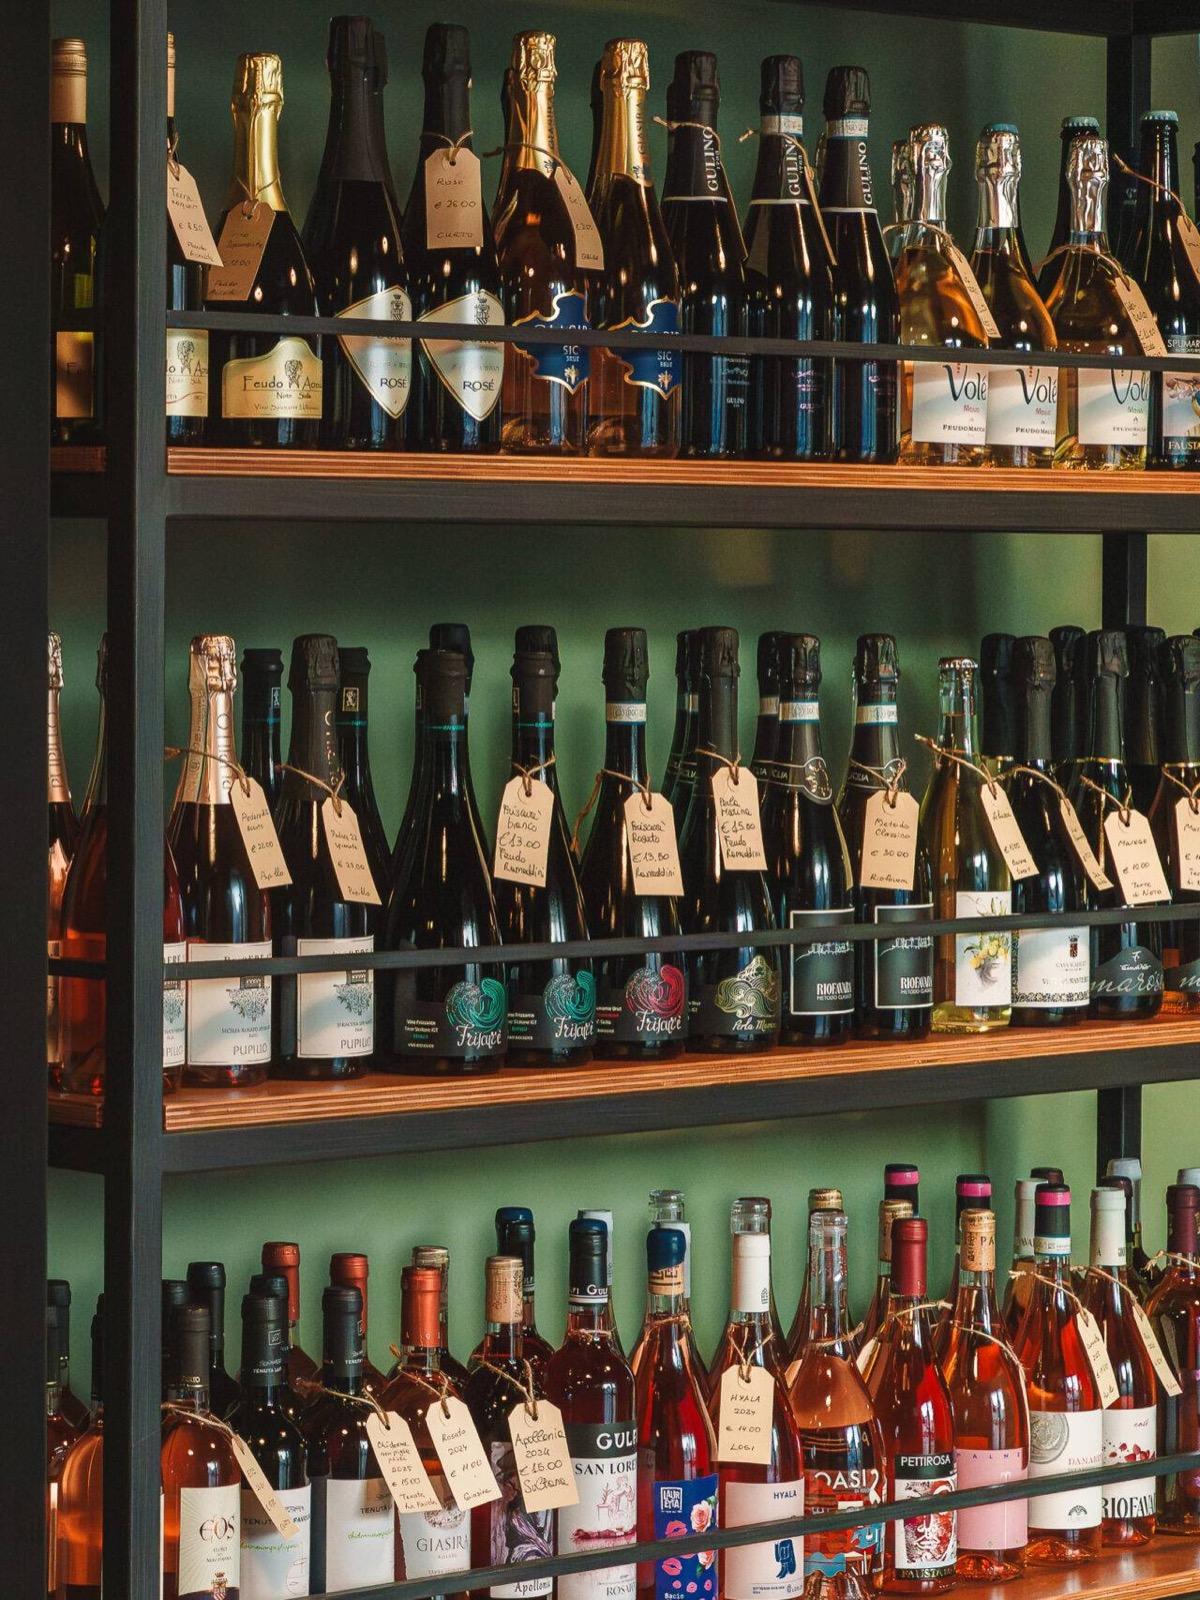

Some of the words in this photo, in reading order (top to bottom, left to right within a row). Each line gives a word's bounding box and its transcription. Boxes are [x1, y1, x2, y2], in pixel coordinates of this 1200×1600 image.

[703, 127, 719, 192] GULINO
[857, 141, 873, 205] GULINO
[242, 375, 284, 391] Feudo
[380, 376, 408, 390] ROSÉ
[462, 378, 495, 393] ROSÉ
[900, 1454, 951, 1467] PETTIROSA
[574, 1463, 604, 1476] SAN
[773, 1489, 797, 1500] HYALA
